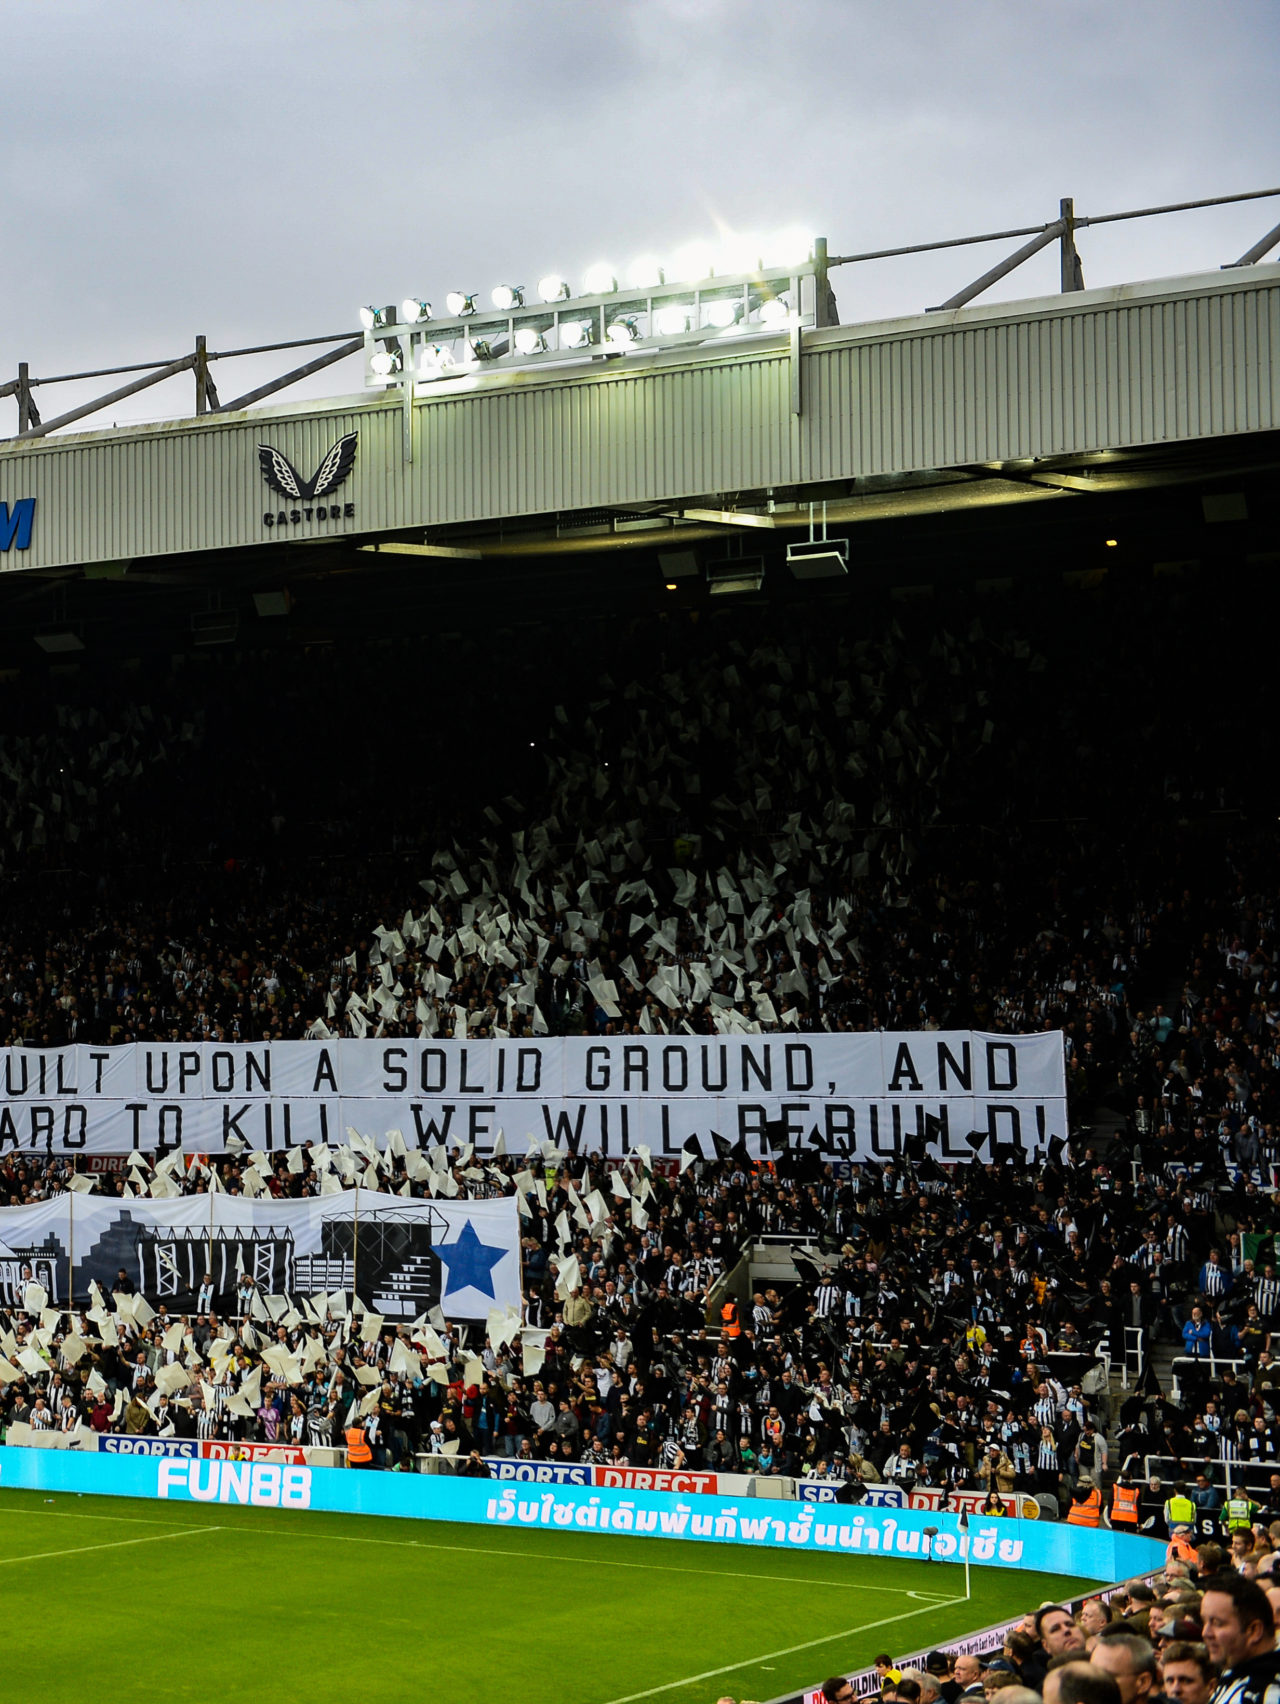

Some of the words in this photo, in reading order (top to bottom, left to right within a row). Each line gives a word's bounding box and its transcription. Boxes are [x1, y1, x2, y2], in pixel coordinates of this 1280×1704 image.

[263, 502, 355, 528] CASTORE
[145, 1049, 271, 1093] UPON
[313, 1048, 338, 1092] A
[383, 1047, 542, 1093] SOLID
[586, 1043, 837, 1095] GROUND,
[888, 1041, 1019, 1092] AND
[124, 1102, 184, 1149] TO
[410, 1103, 496, 1153] WE
[542, 1103, 684, 1155] WILL
[105, 1439, 193, 1459] SPORTS
[157, 1458, 312, 1508] FUN88
[604, 1470, 709, 1494] DIRECT
